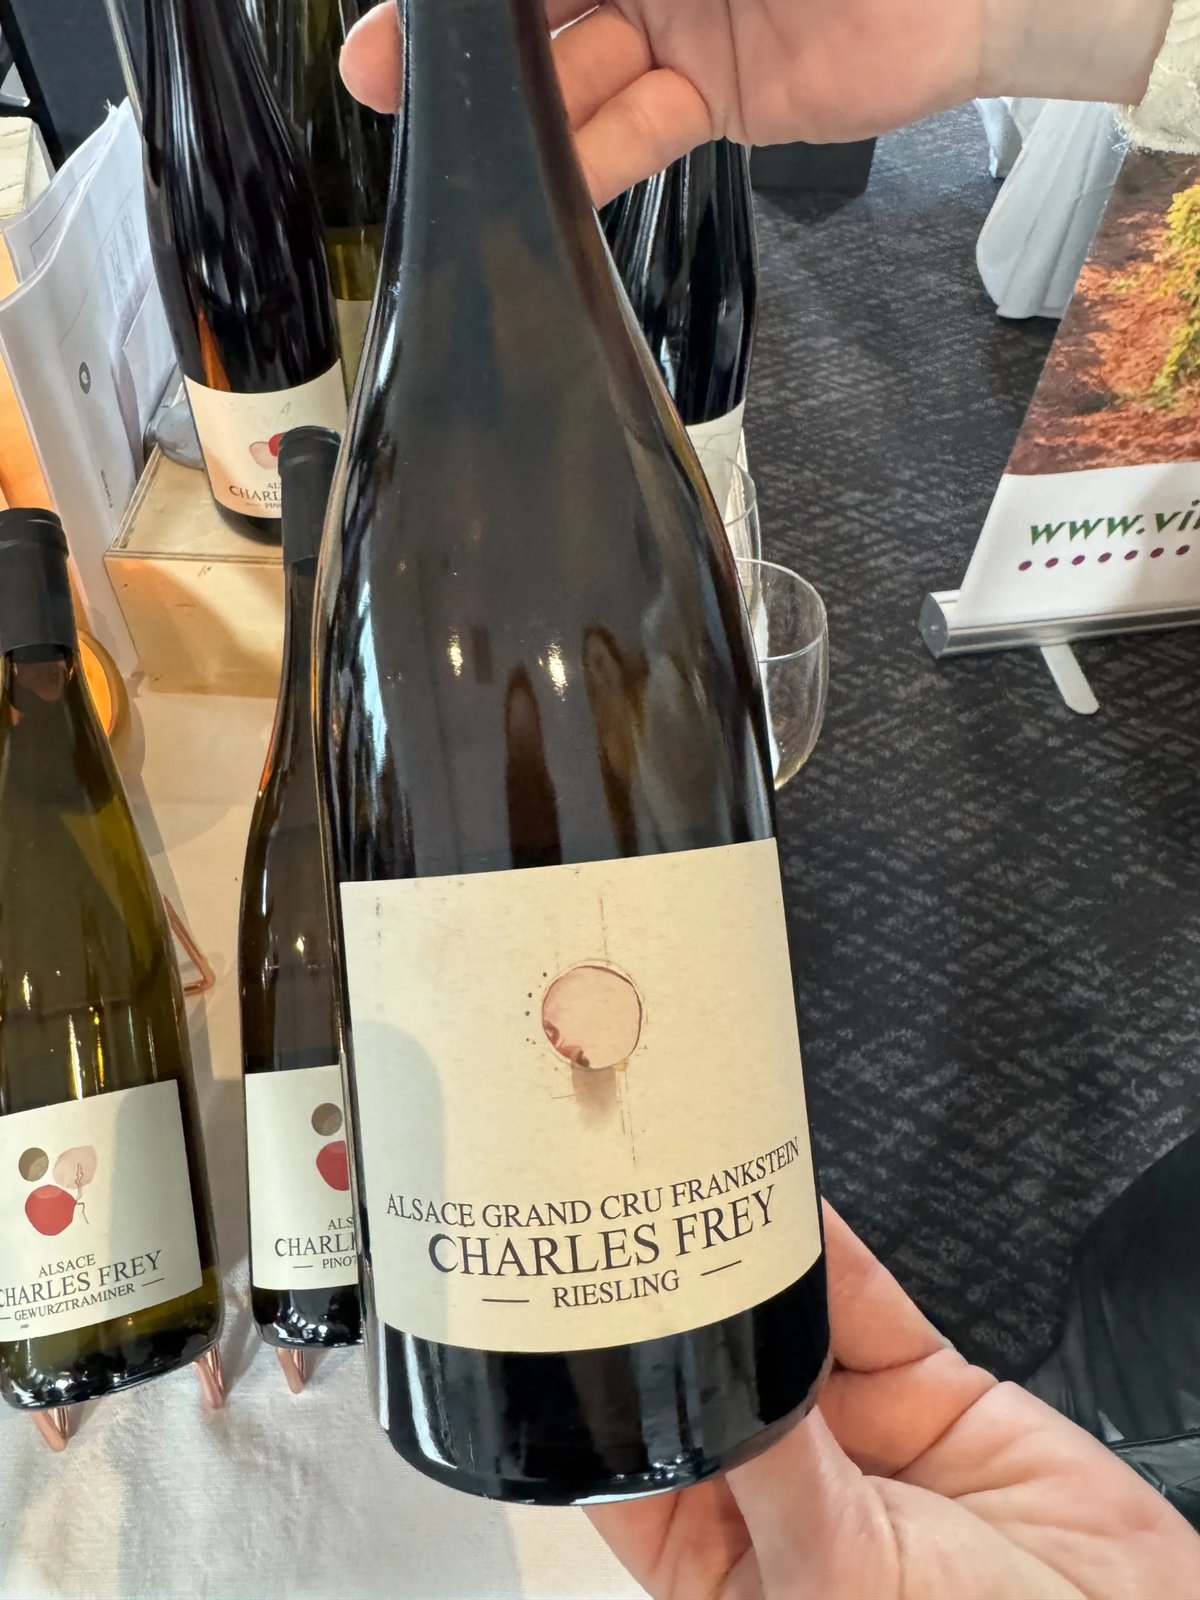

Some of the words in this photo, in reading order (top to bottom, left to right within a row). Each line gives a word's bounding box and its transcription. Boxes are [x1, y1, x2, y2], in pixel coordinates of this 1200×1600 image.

[386, 1193, 476, 1227] ALSACE
[482, 1199, 593, 1229] GRAND
[600, 1187, 663, 1221] CRU
[671, 1136, 801, 1208] FRANKSTEIN
[428, 1222, 661, 1278] CHARLES
[673, 1183, 777, 1257] FREY
[39, 1253, 97, 1278] ALSACE
[97, 1248, 163, 1287] FREY
[14, 1282, 136, 1321] GEWURZTRAMINER
[552, 1268, 681, 1309] RIESLING
